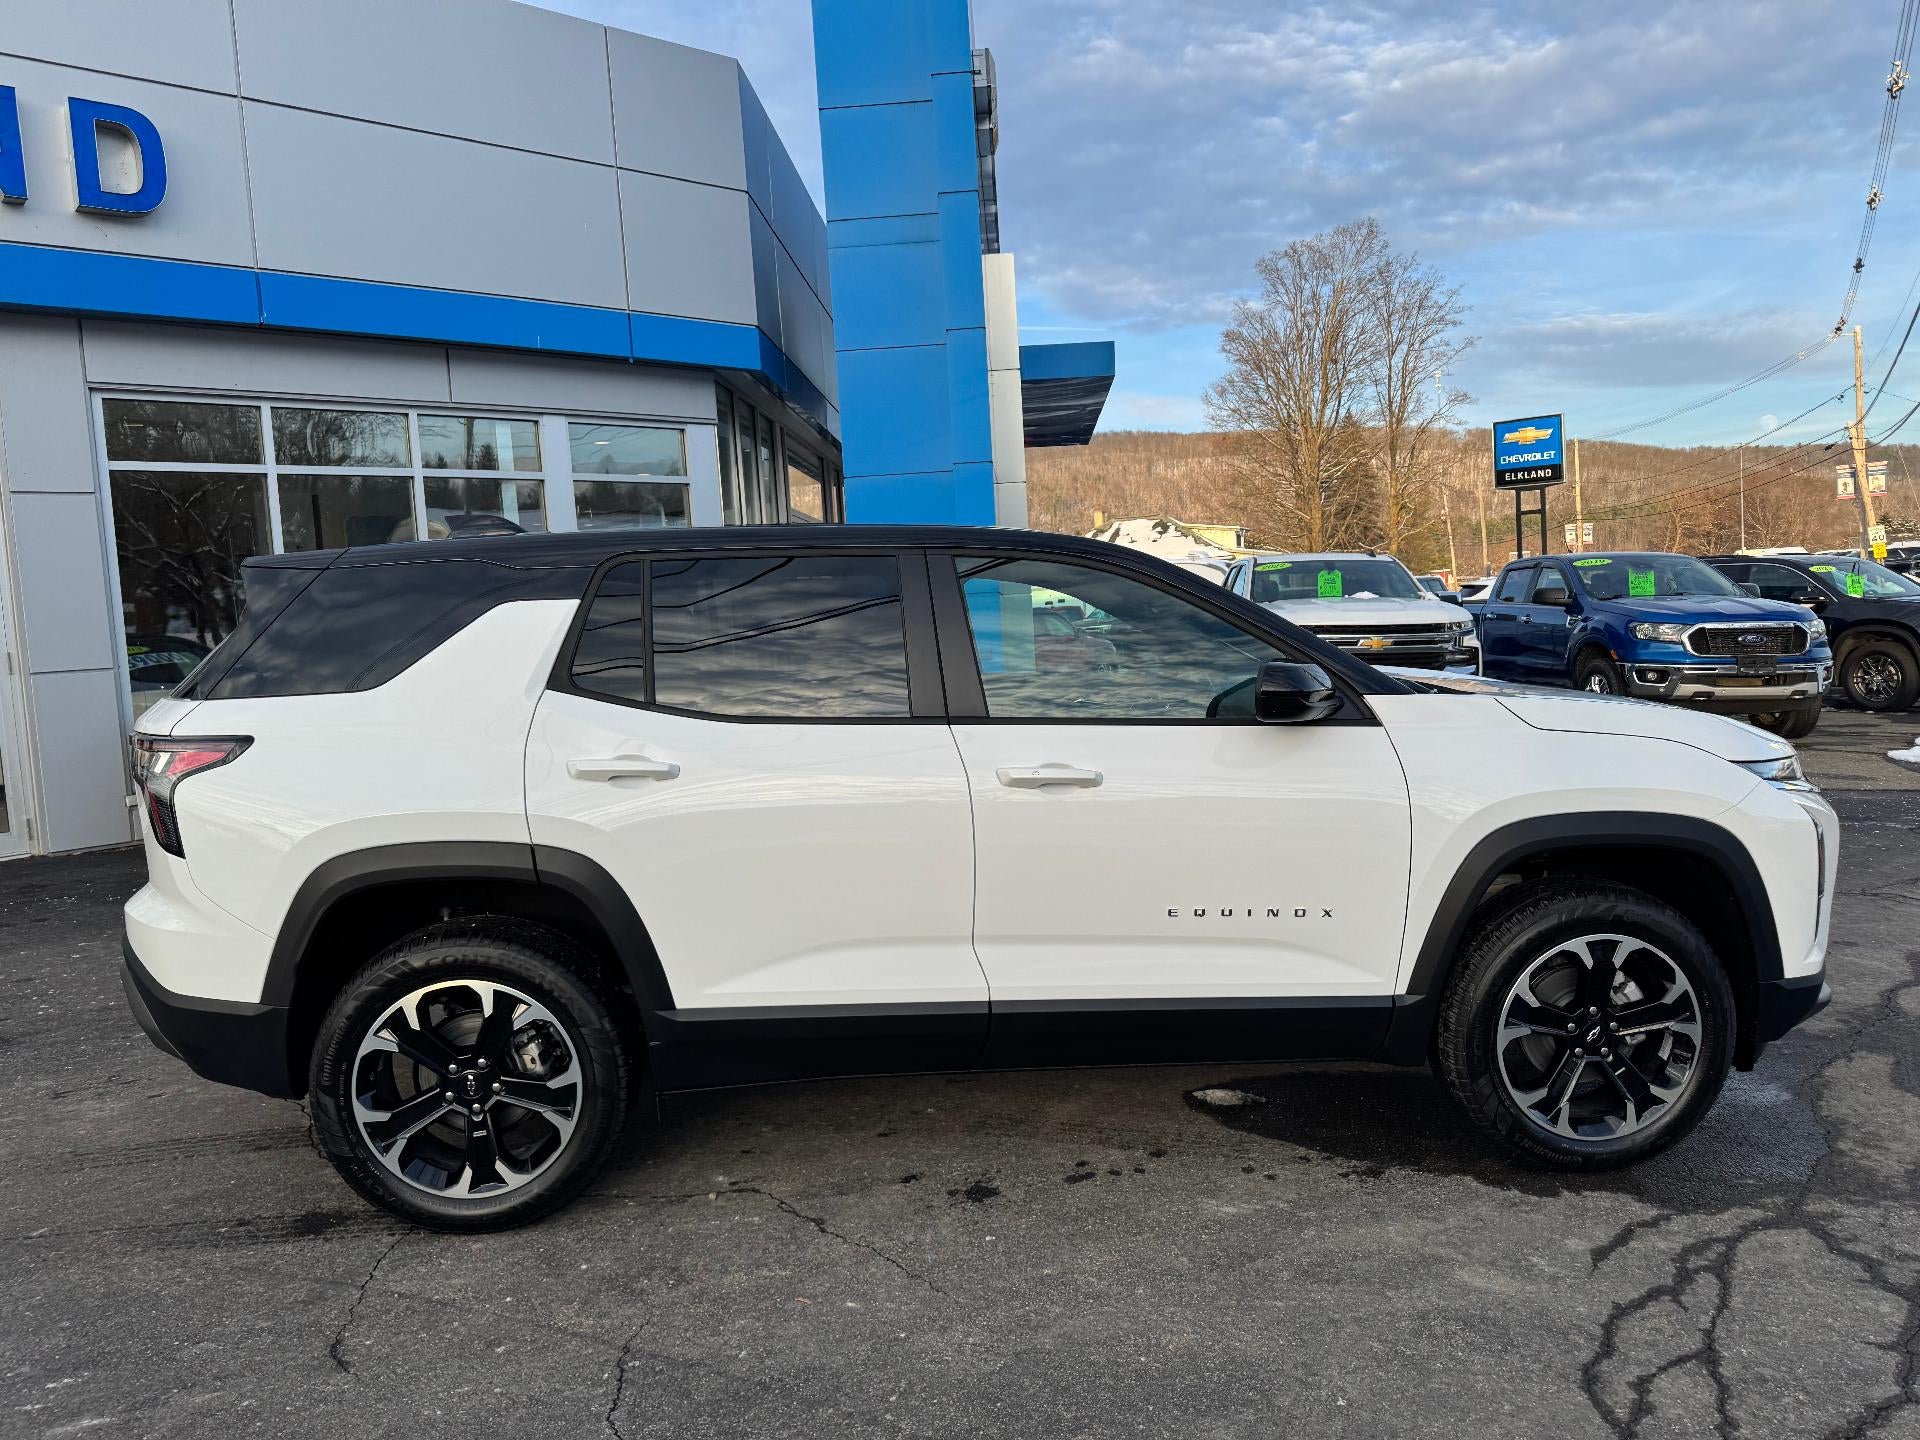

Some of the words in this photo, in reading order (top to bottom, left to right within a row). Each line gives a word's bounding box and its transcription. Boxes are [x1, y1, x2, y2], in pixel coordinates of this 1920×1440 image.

[0, 85, 168, 217] D
[1500, 450, 1556, 465] CHEVROLET
[1505, 468, 1552, 481] ELKLAND
[1167, 907, 1334, 918] EQUINOX
